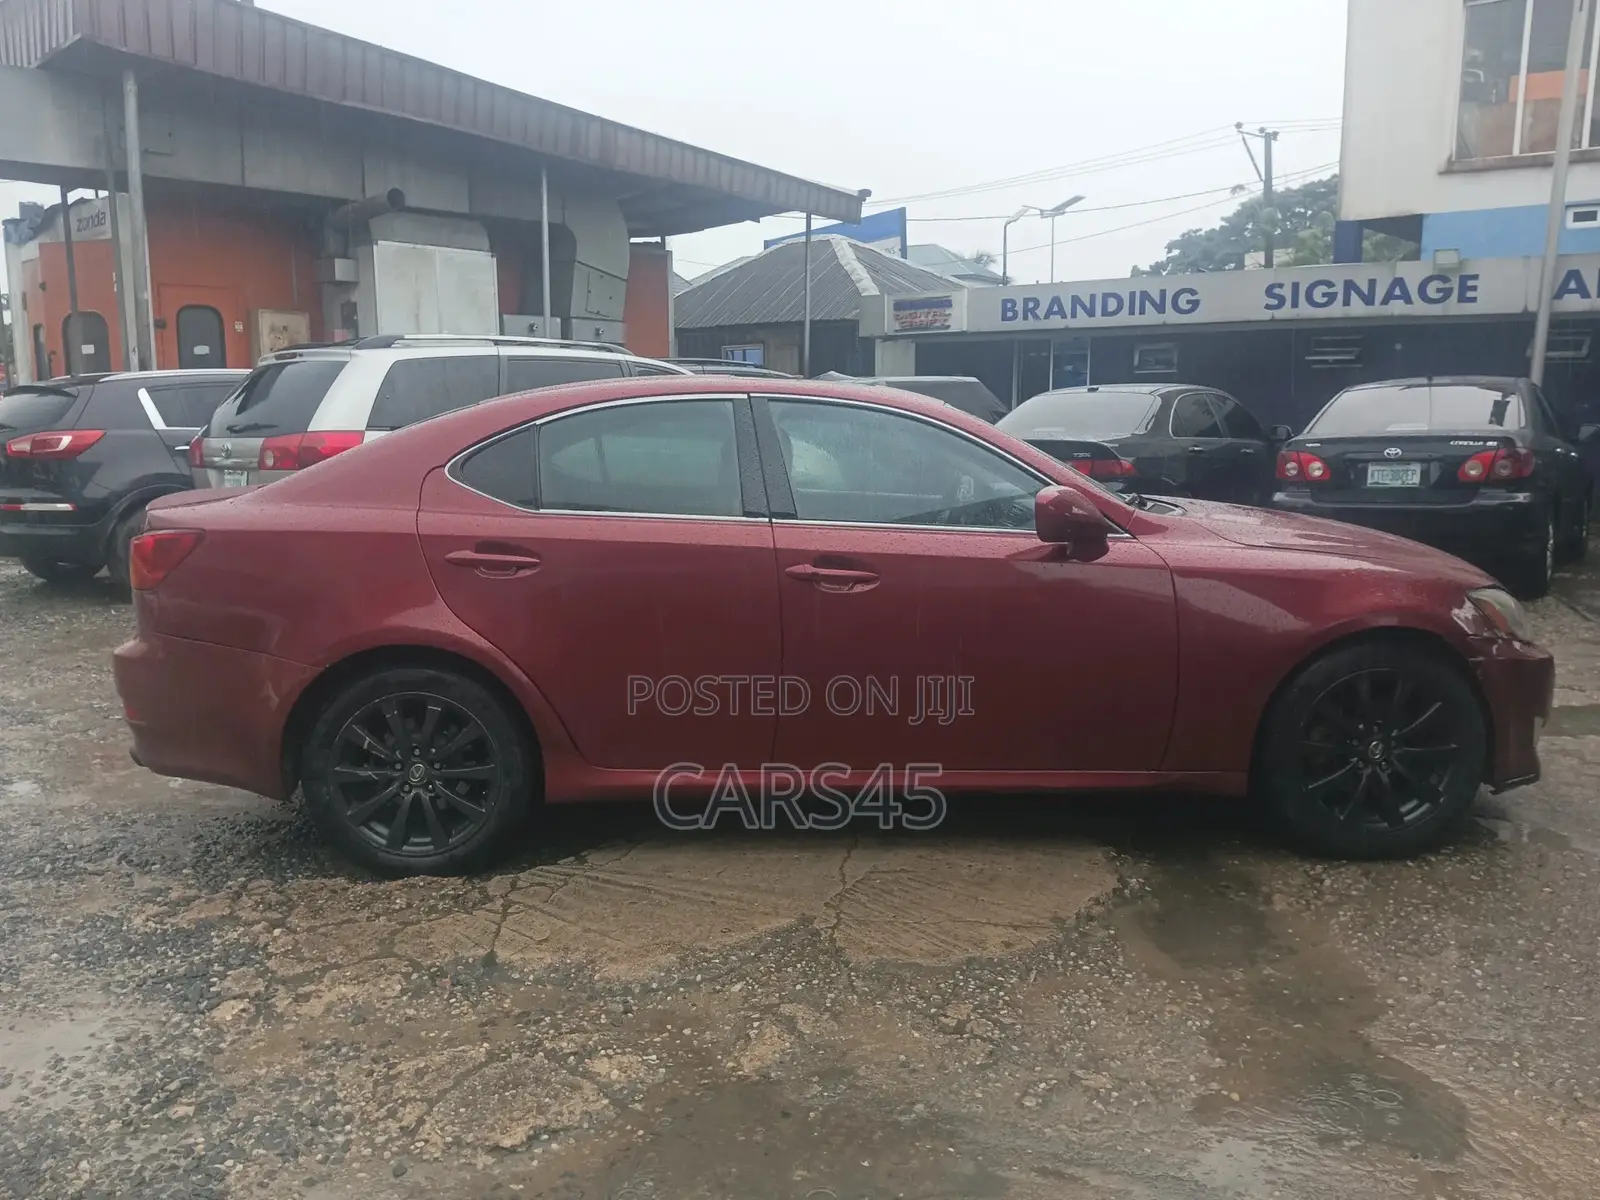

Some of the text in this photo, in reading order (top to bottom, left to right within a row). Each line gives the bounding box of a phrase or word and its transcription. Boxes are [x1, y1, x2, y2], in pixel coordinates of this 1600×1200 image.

[76, 209, 106, 232] zonda
[1000, 287, 1200, 322] BRANDING
[1264, 273, 1480, 310] SIGNAGE
